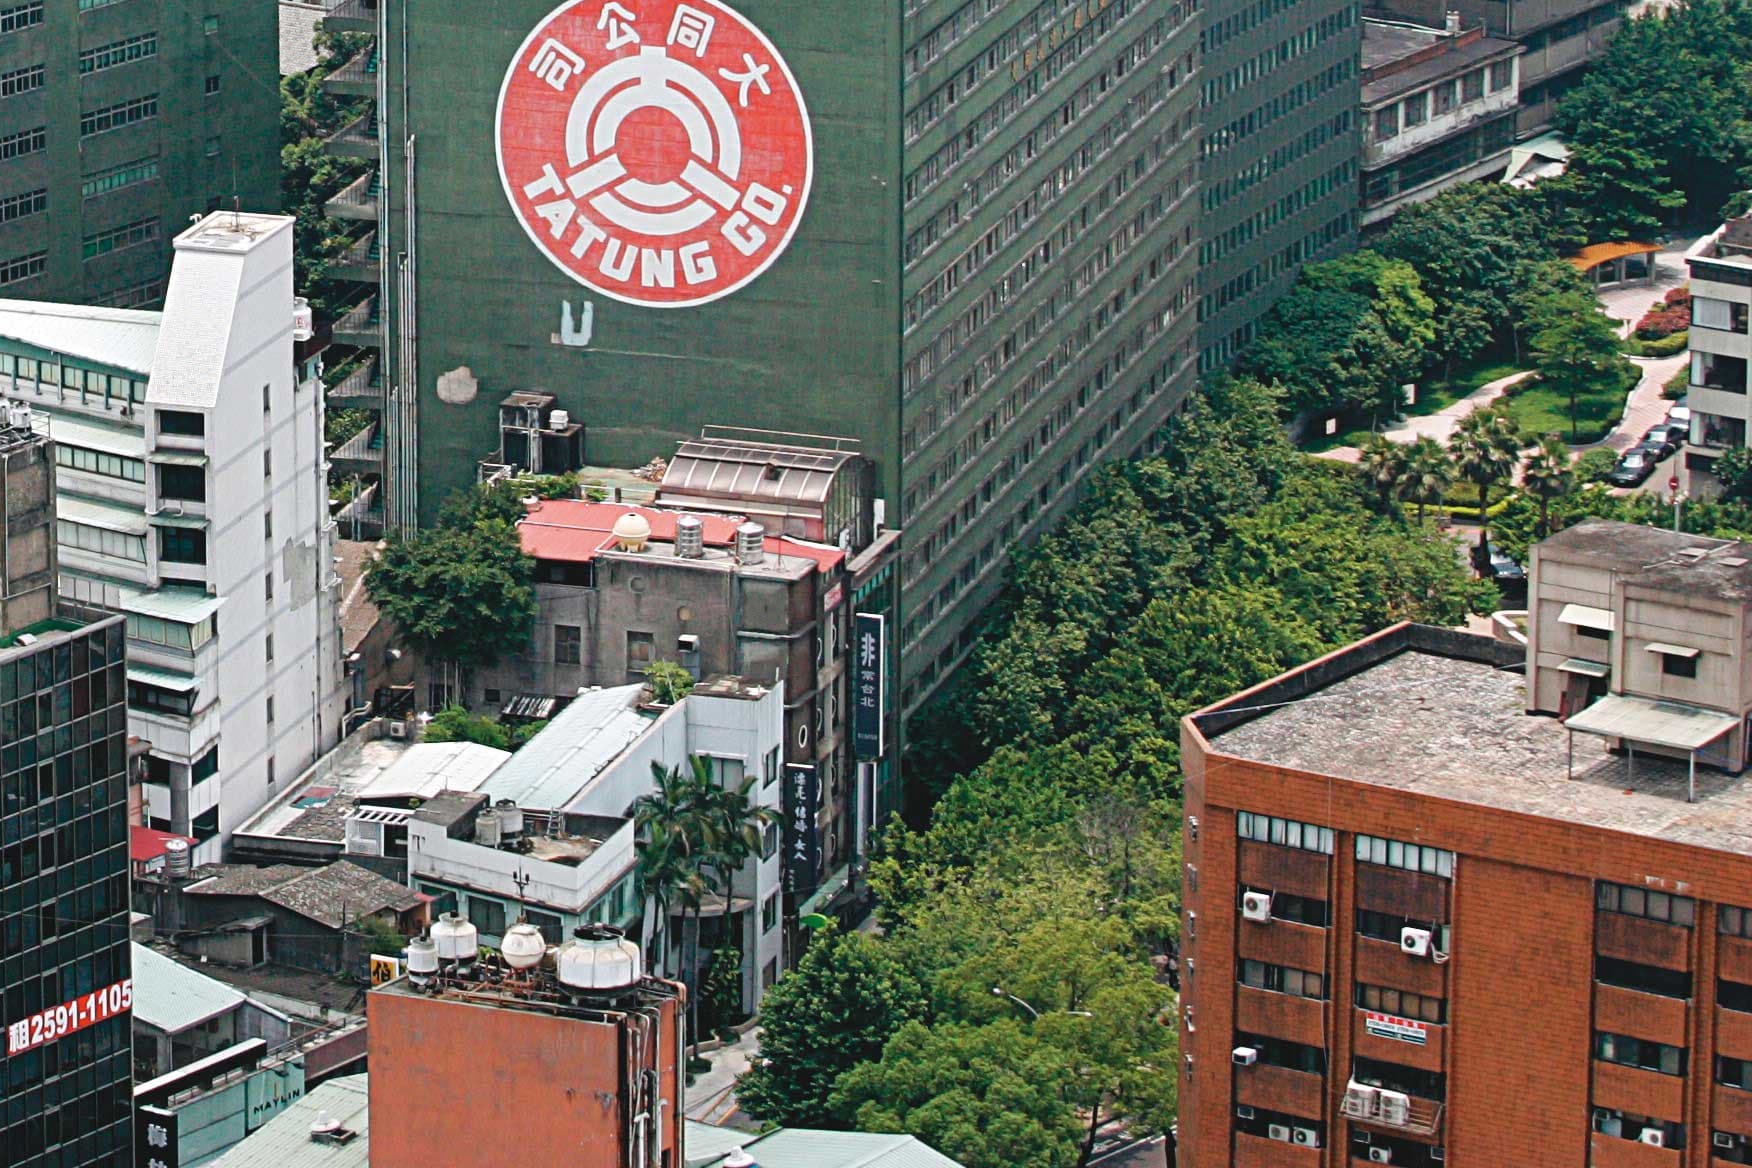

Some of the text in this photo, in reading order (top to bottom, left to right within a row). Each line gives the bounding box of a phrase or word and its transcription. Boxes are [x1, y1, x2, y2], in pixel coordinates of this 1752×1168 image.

[523, 162, 793, 288] TATUNG CO.
[253, 1088, 301, 1115] MAYLIN
